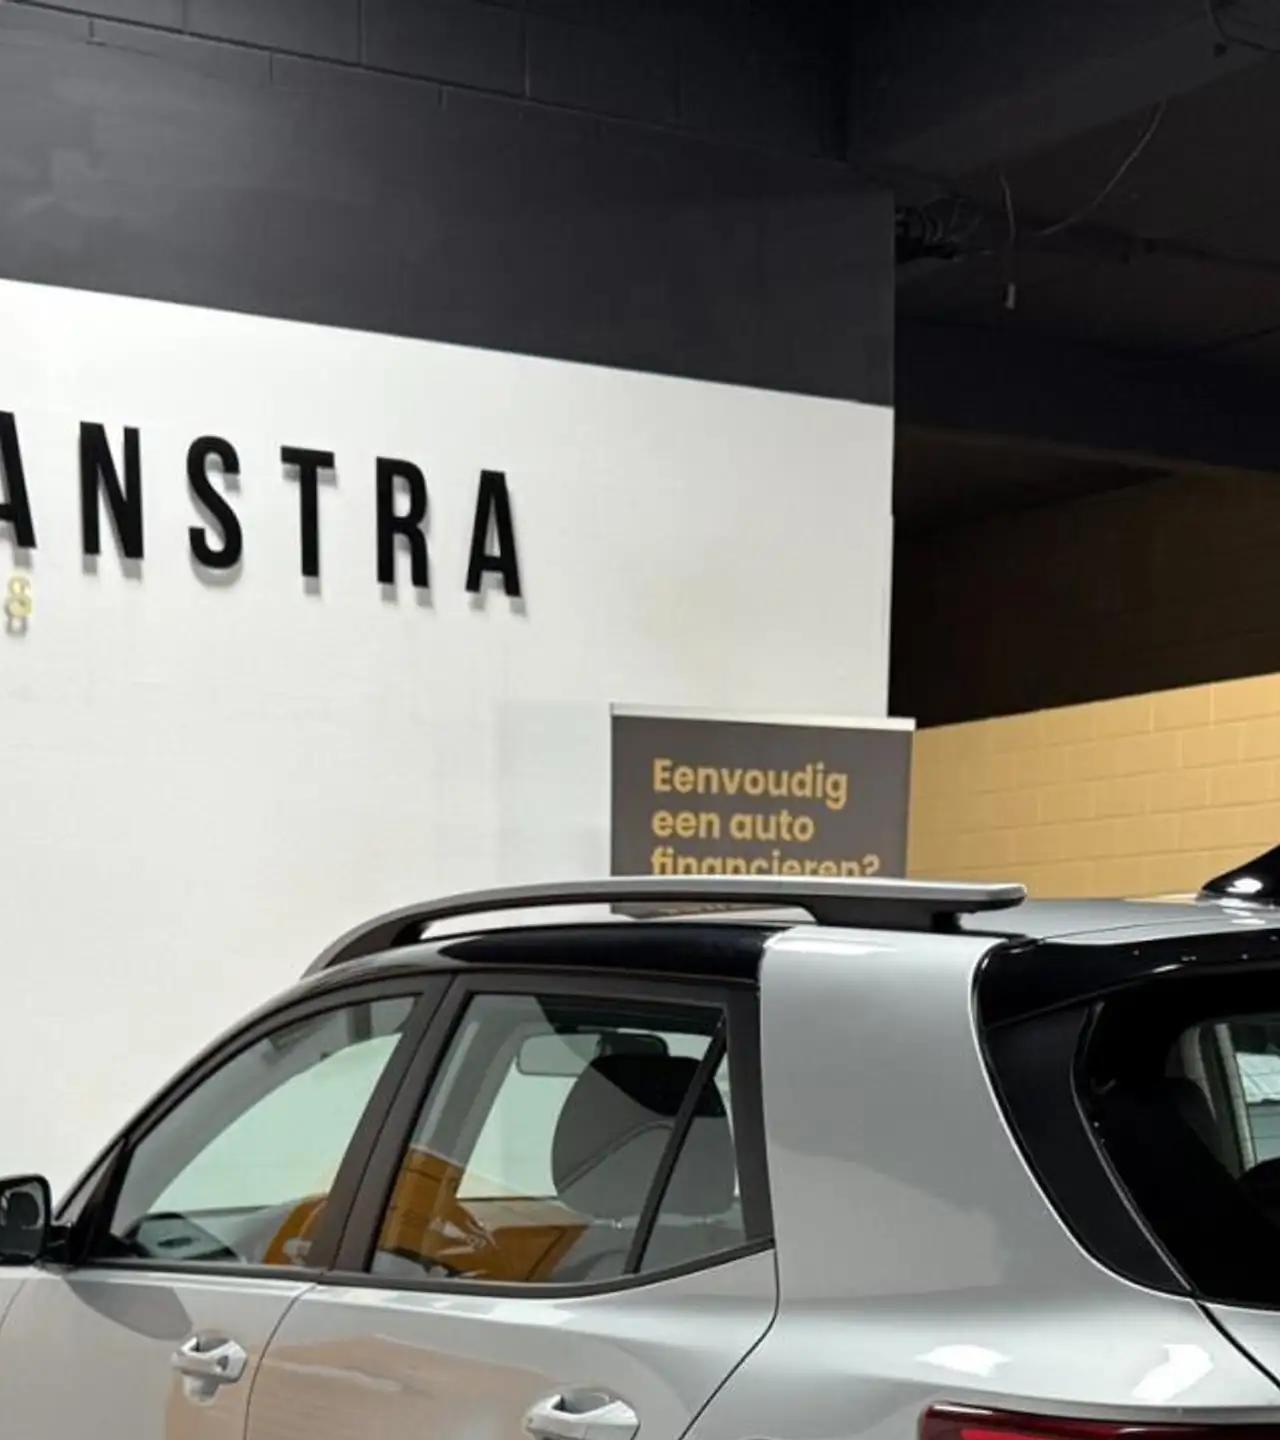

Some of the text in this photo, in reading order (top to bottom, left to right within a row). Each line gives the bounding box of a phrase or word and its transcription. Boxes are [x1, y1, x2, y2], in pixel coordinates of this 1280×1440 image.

[652, 757, 849, 811] Eenvoudig
[651, 809, 815, 842] een auto
